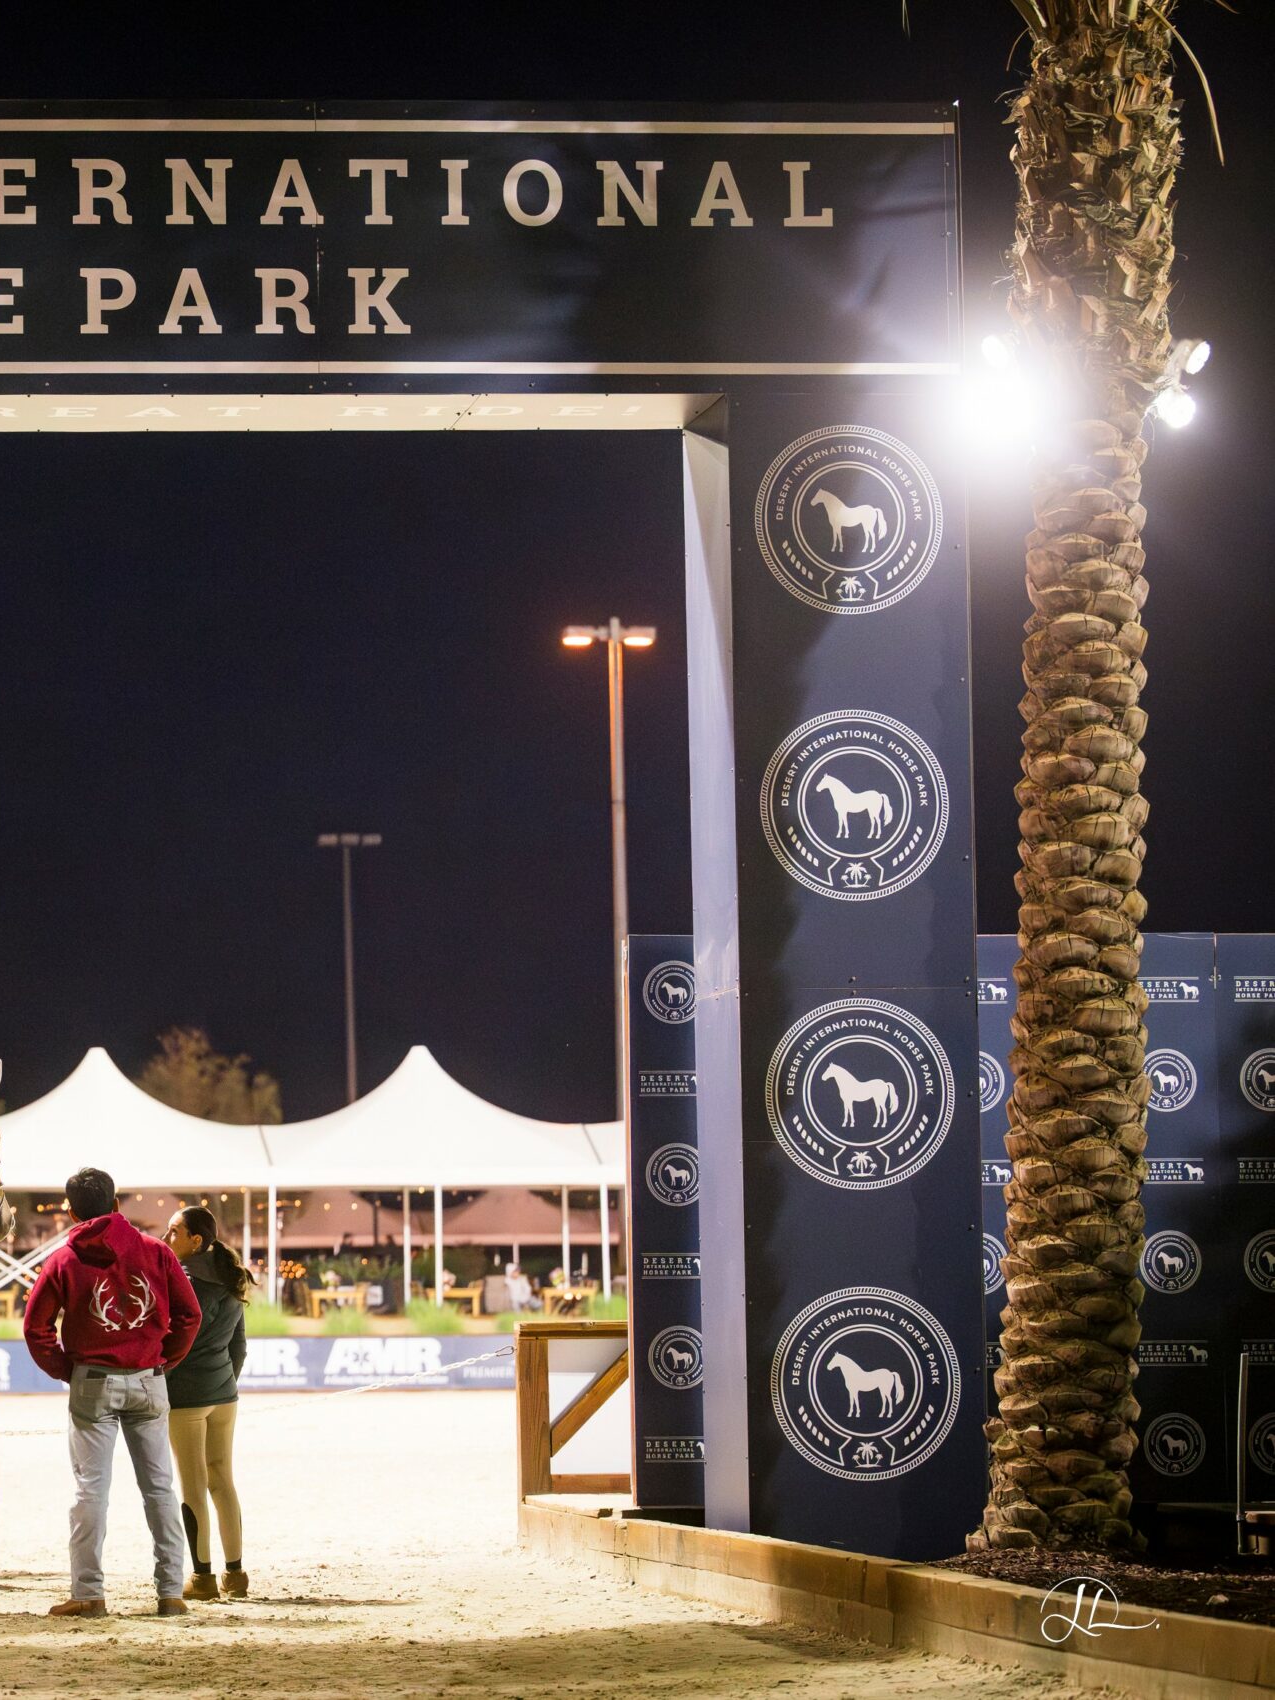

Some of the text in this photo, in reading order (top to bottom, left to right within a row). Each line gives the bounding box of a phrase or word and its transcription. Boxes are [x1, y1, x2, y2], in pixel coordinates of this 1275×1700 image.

[79, 267, 412, 335] PARK
[336, 405, 645, 417] RIDE!
[775, 445, 923, 521] DESERT INTERNATIONAL HORSE PARK
[781, 729, 928, 807] DESERT INTERNATIONAL HORSE PARK
[786, 1018, 934, 1096] DESERT INTERNATIONAL HORSE PARK
[323, 1337, 443, 1375] AMR
[791, 1307, 940, 1386] DESERT INTERNATIONAL HORSE PARK
